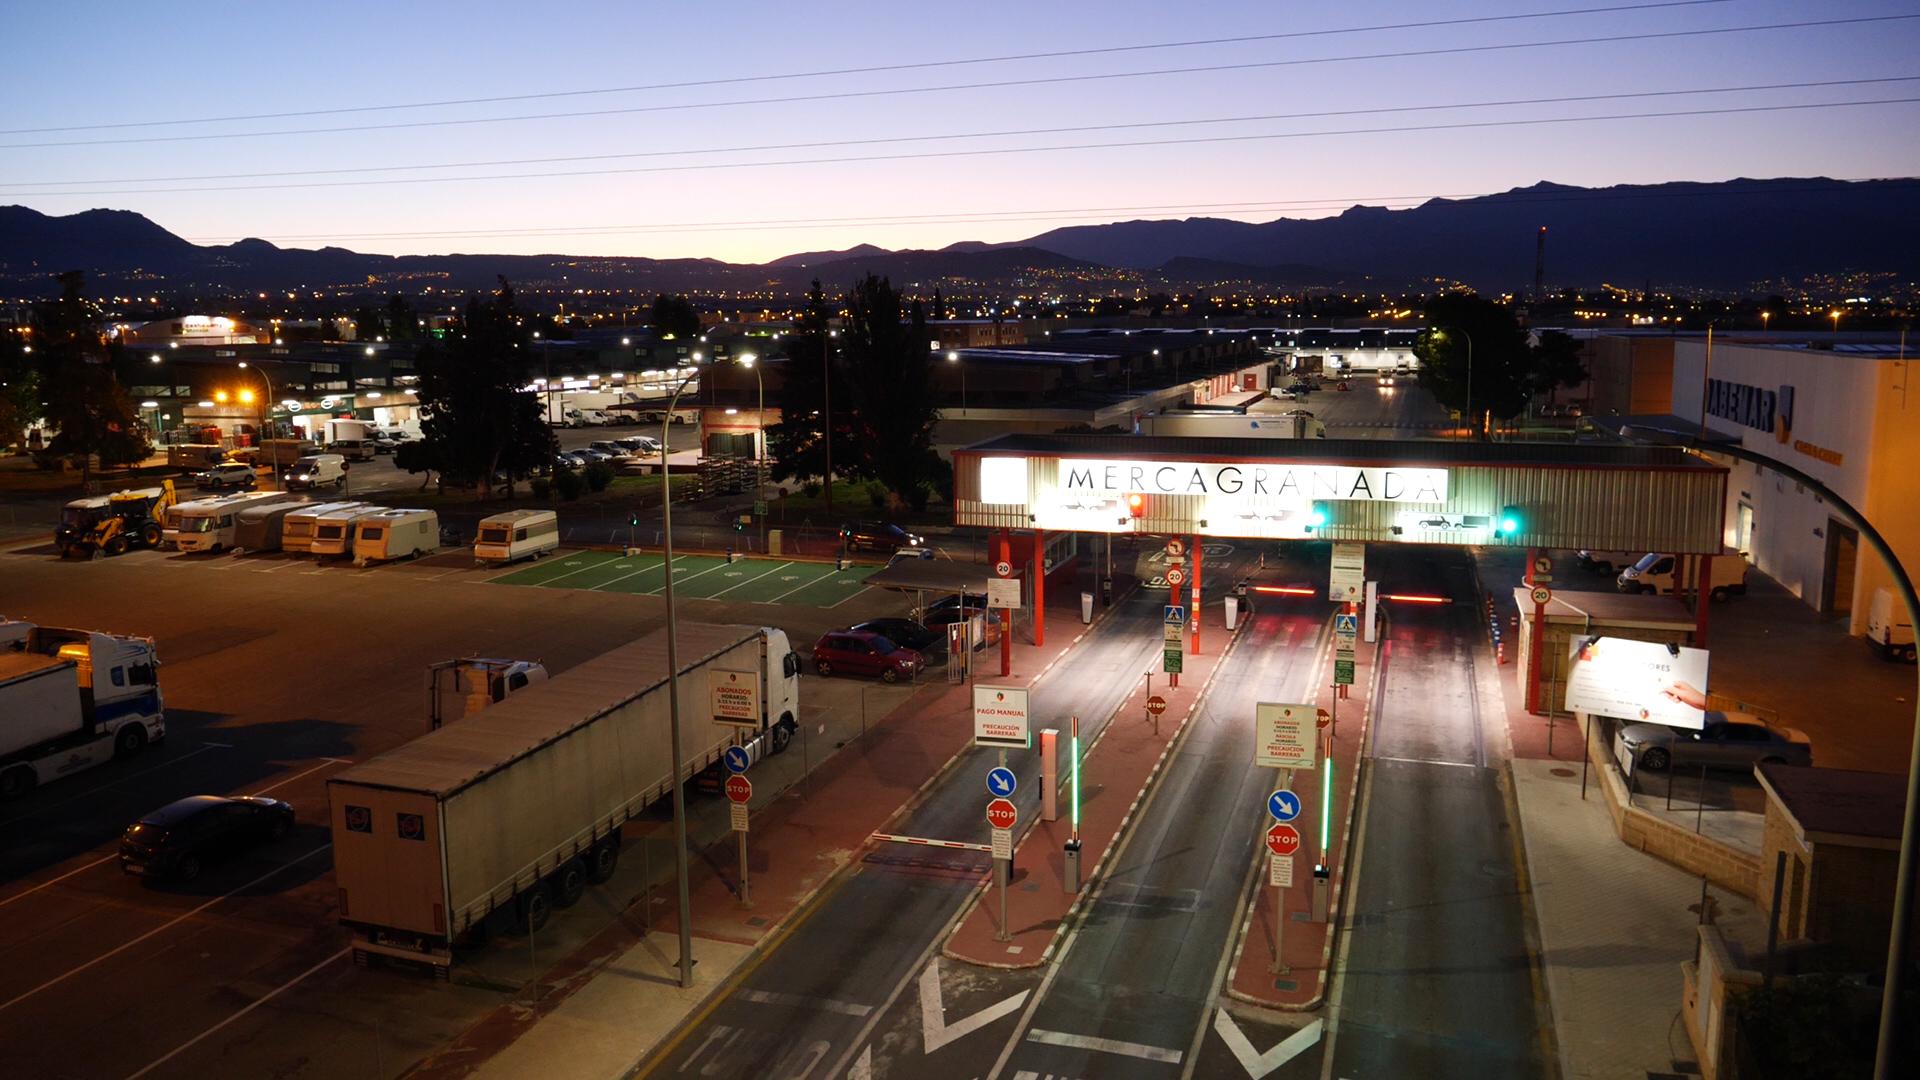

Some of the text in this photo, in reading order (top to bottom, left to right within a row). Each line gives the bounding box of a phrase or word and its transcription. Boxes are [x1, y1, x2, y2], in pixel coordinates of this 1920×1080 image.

[1068, 466, 1439, 500] MERCAGRANADA
[1169, 573, 1180, 581] 20
[1535, 591, 1547, 599] 20
[716, 687, 752, 695] ABONADOS
[996, 709, 1025, 717] MANUAL
[727, 785, 750, 794] STOP
[988, 810, 1015, 818] STOP
[1268, 835, 1298, 845] STOP
